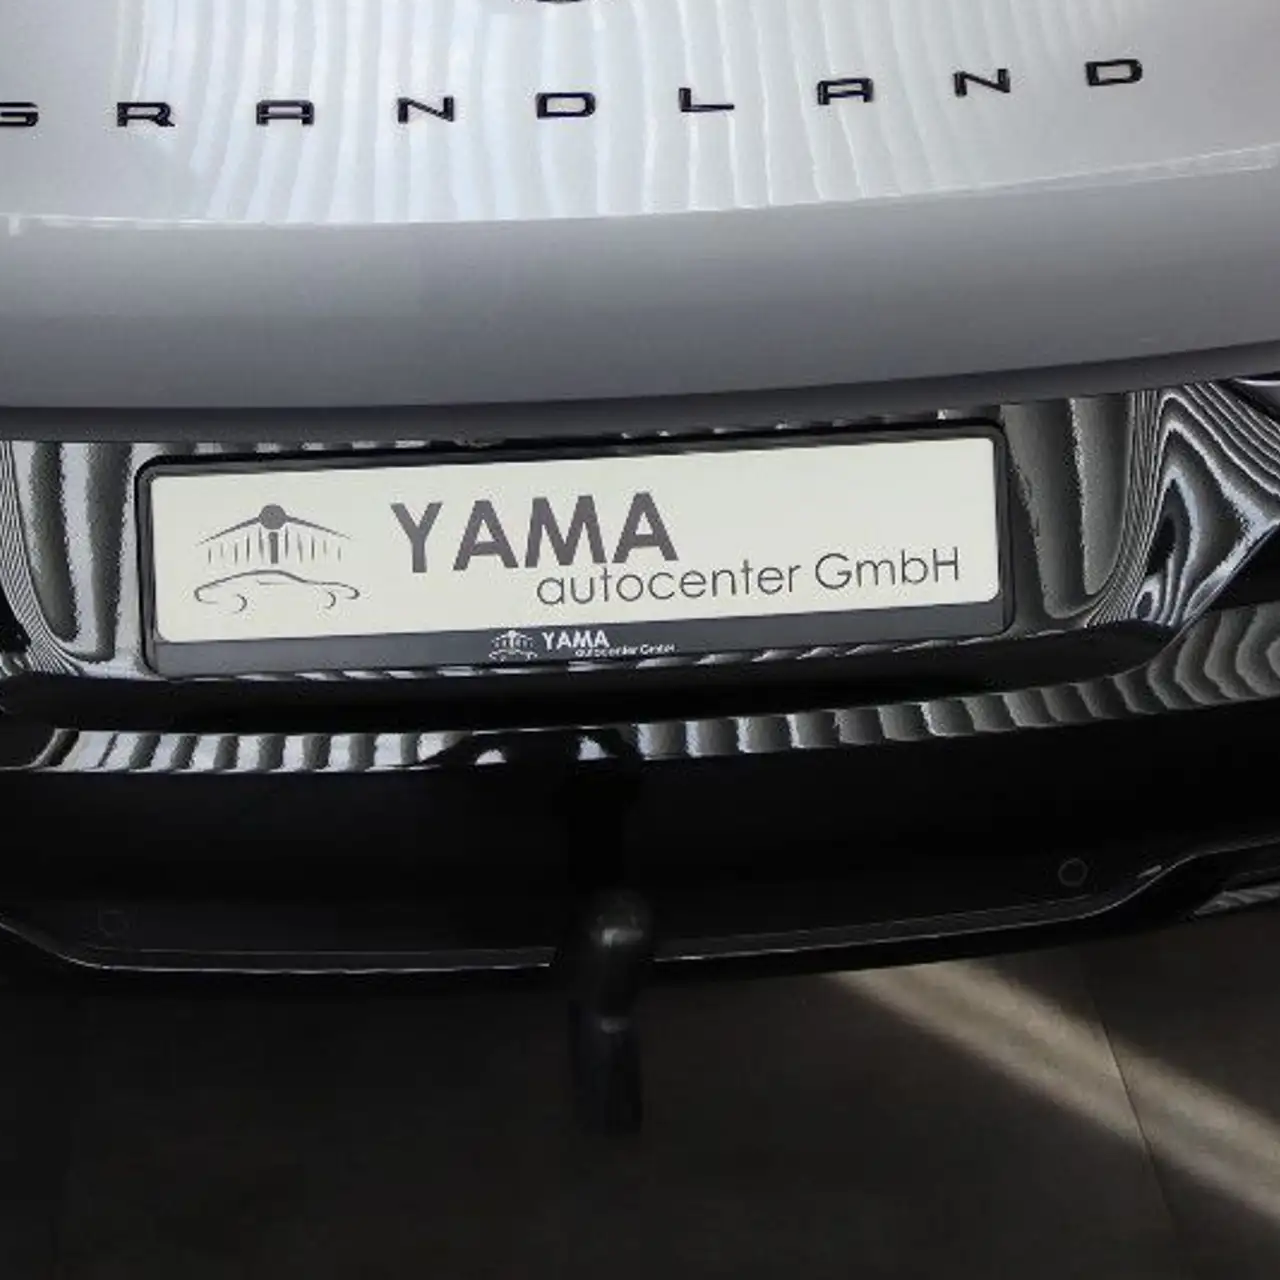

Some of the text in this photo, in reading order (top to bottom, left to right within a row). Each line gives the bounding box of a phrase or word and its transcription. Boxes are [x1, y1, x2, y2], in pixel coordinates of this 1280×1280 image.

[390, 492, 679, 573] YAMA
[537, 547, 960, 606] autocenter GmbH
[542, 629, 610, 650] YAMA
